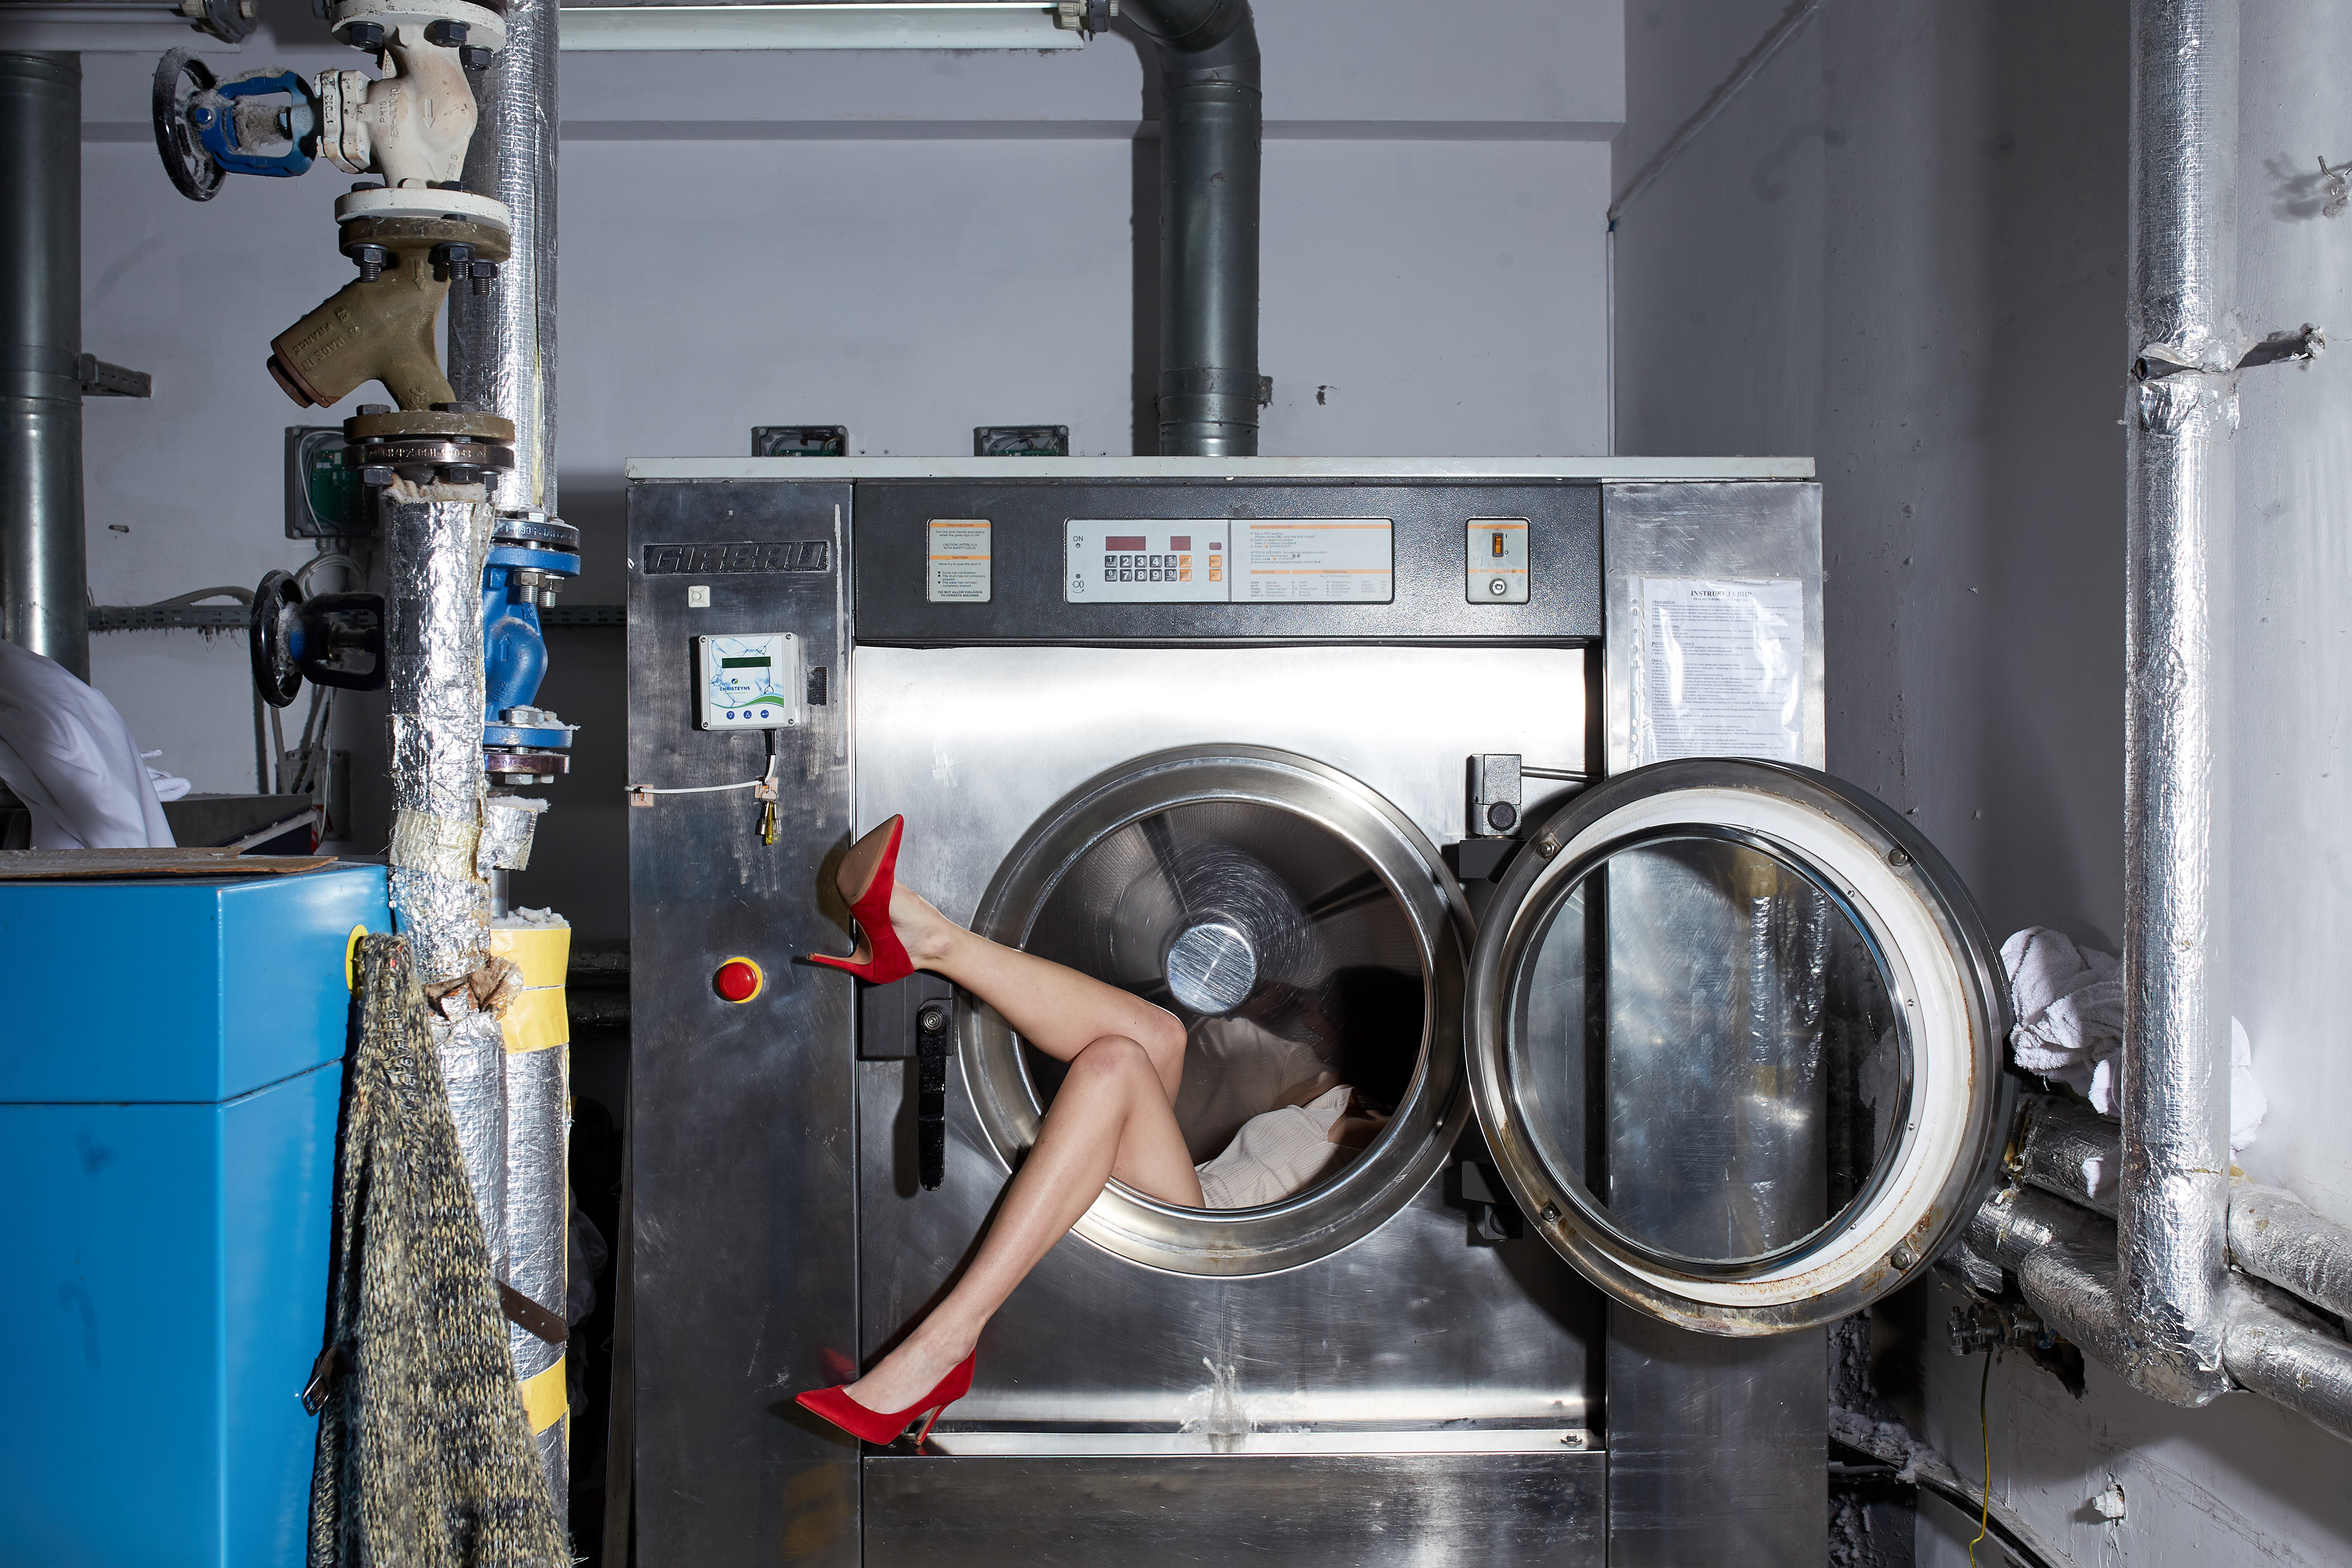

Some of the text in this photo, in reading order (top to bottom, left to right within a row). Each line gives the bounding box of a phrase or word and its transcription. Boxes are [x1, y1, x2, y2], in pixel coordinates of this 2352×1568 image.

[292, 322, 333, 355] FRANCE
[301, 336, 346, 371] MADE IN
[649, 545, 824, 572] GIRBAU
